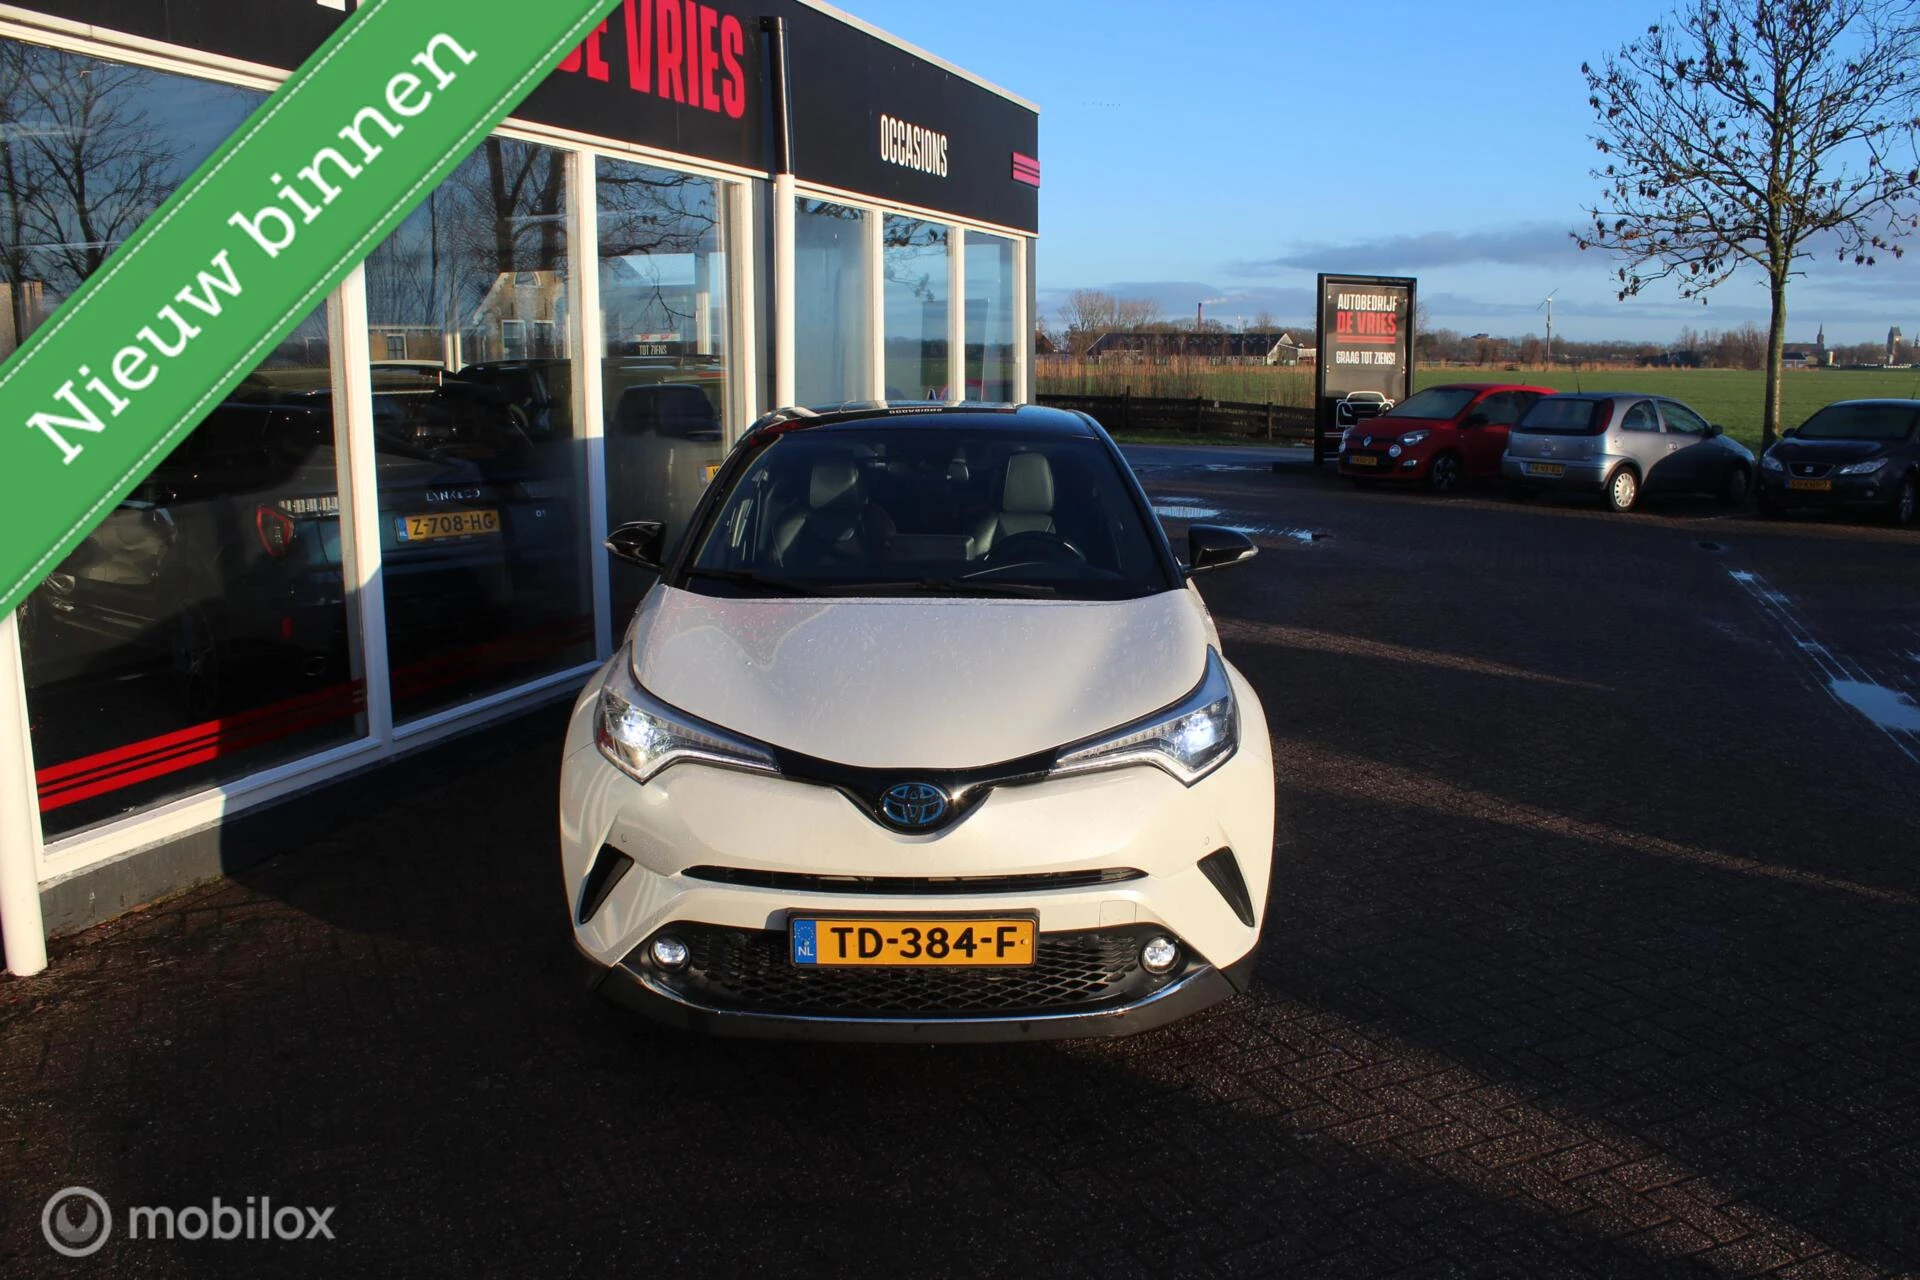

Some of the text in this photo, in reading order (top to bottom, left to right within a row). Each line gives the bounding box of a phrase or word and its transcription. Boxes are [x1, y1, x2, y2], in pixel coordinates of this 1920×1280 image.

[623, 0, 745, 119] VRIES
[880, 114, 948, 178] OCCASIONS
[1337, 293, 1398, 312] AUTOBEDRIJF
[1336, 312, 1397, 334] DE VRIES
[1336, 350, 1396, 366] GRAAG TOT ZIENS!
[411, 512, 496, 536] Z-708-HG
[797, 926, 1018, 959] NL TD-384-F
